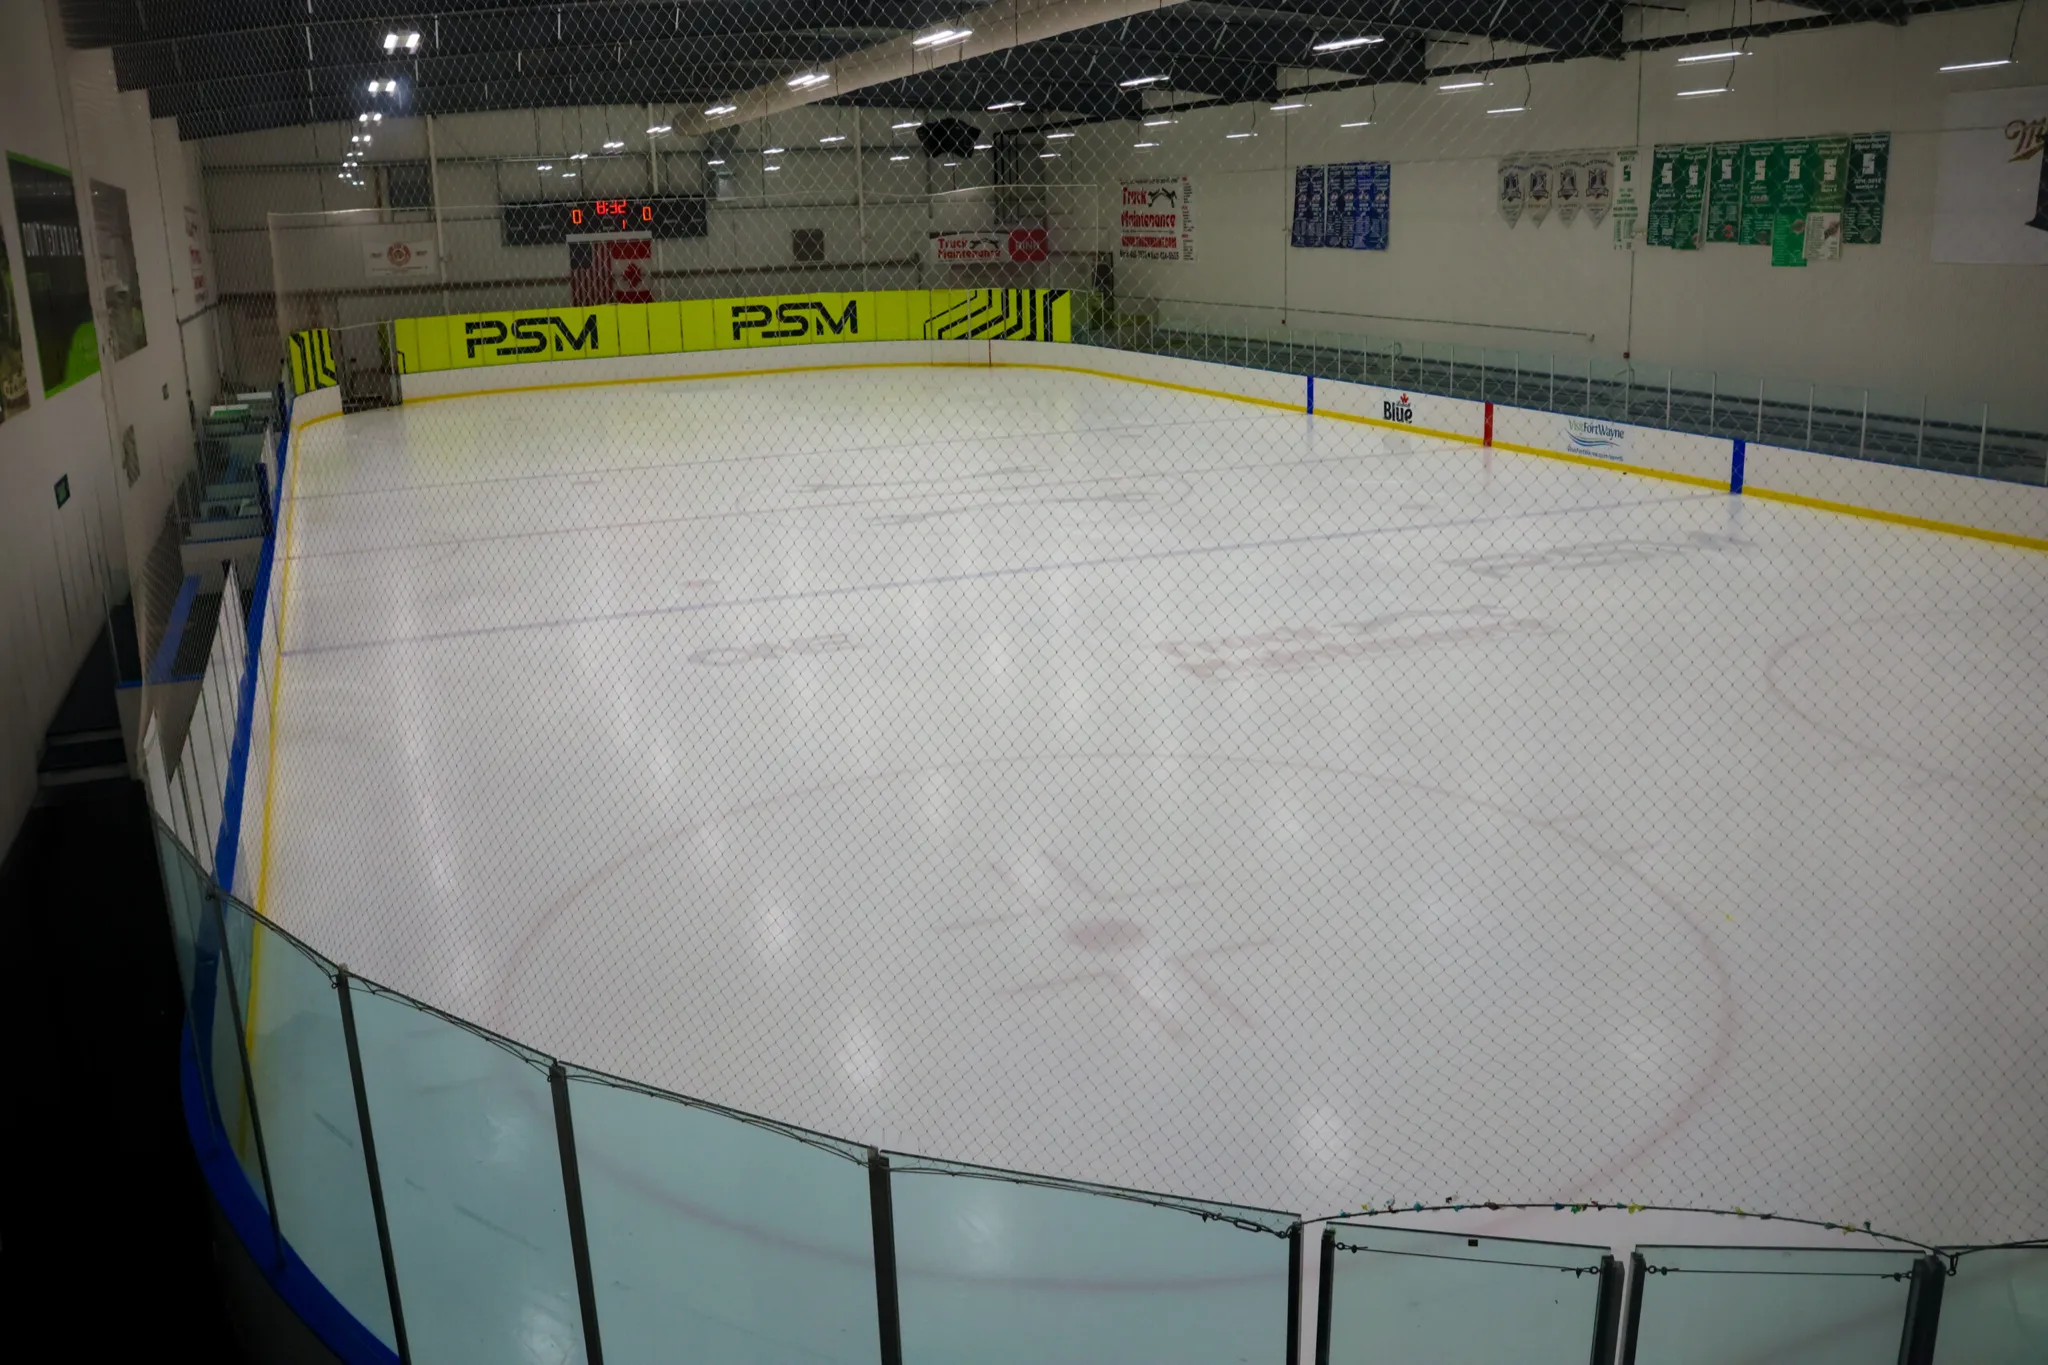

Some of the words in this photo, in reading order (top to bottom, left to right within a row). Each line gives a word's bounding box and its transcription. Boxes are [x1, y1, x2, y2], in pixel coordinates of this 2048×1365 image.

[1122, 187, 1147, 205] Truck
[573, 209, 582, 224] 0
[643, 206, 653, 221] 0
[1121, 210, 1176, 228] Maintenance
[938, 239, 968, 249] Truck
[938, 249, 1001, 259] Maintenance
[732, 301, 859, 340] PSM
[465, 314, 600, 358] PSM
[1384, 401, 1413, 424] Blue
